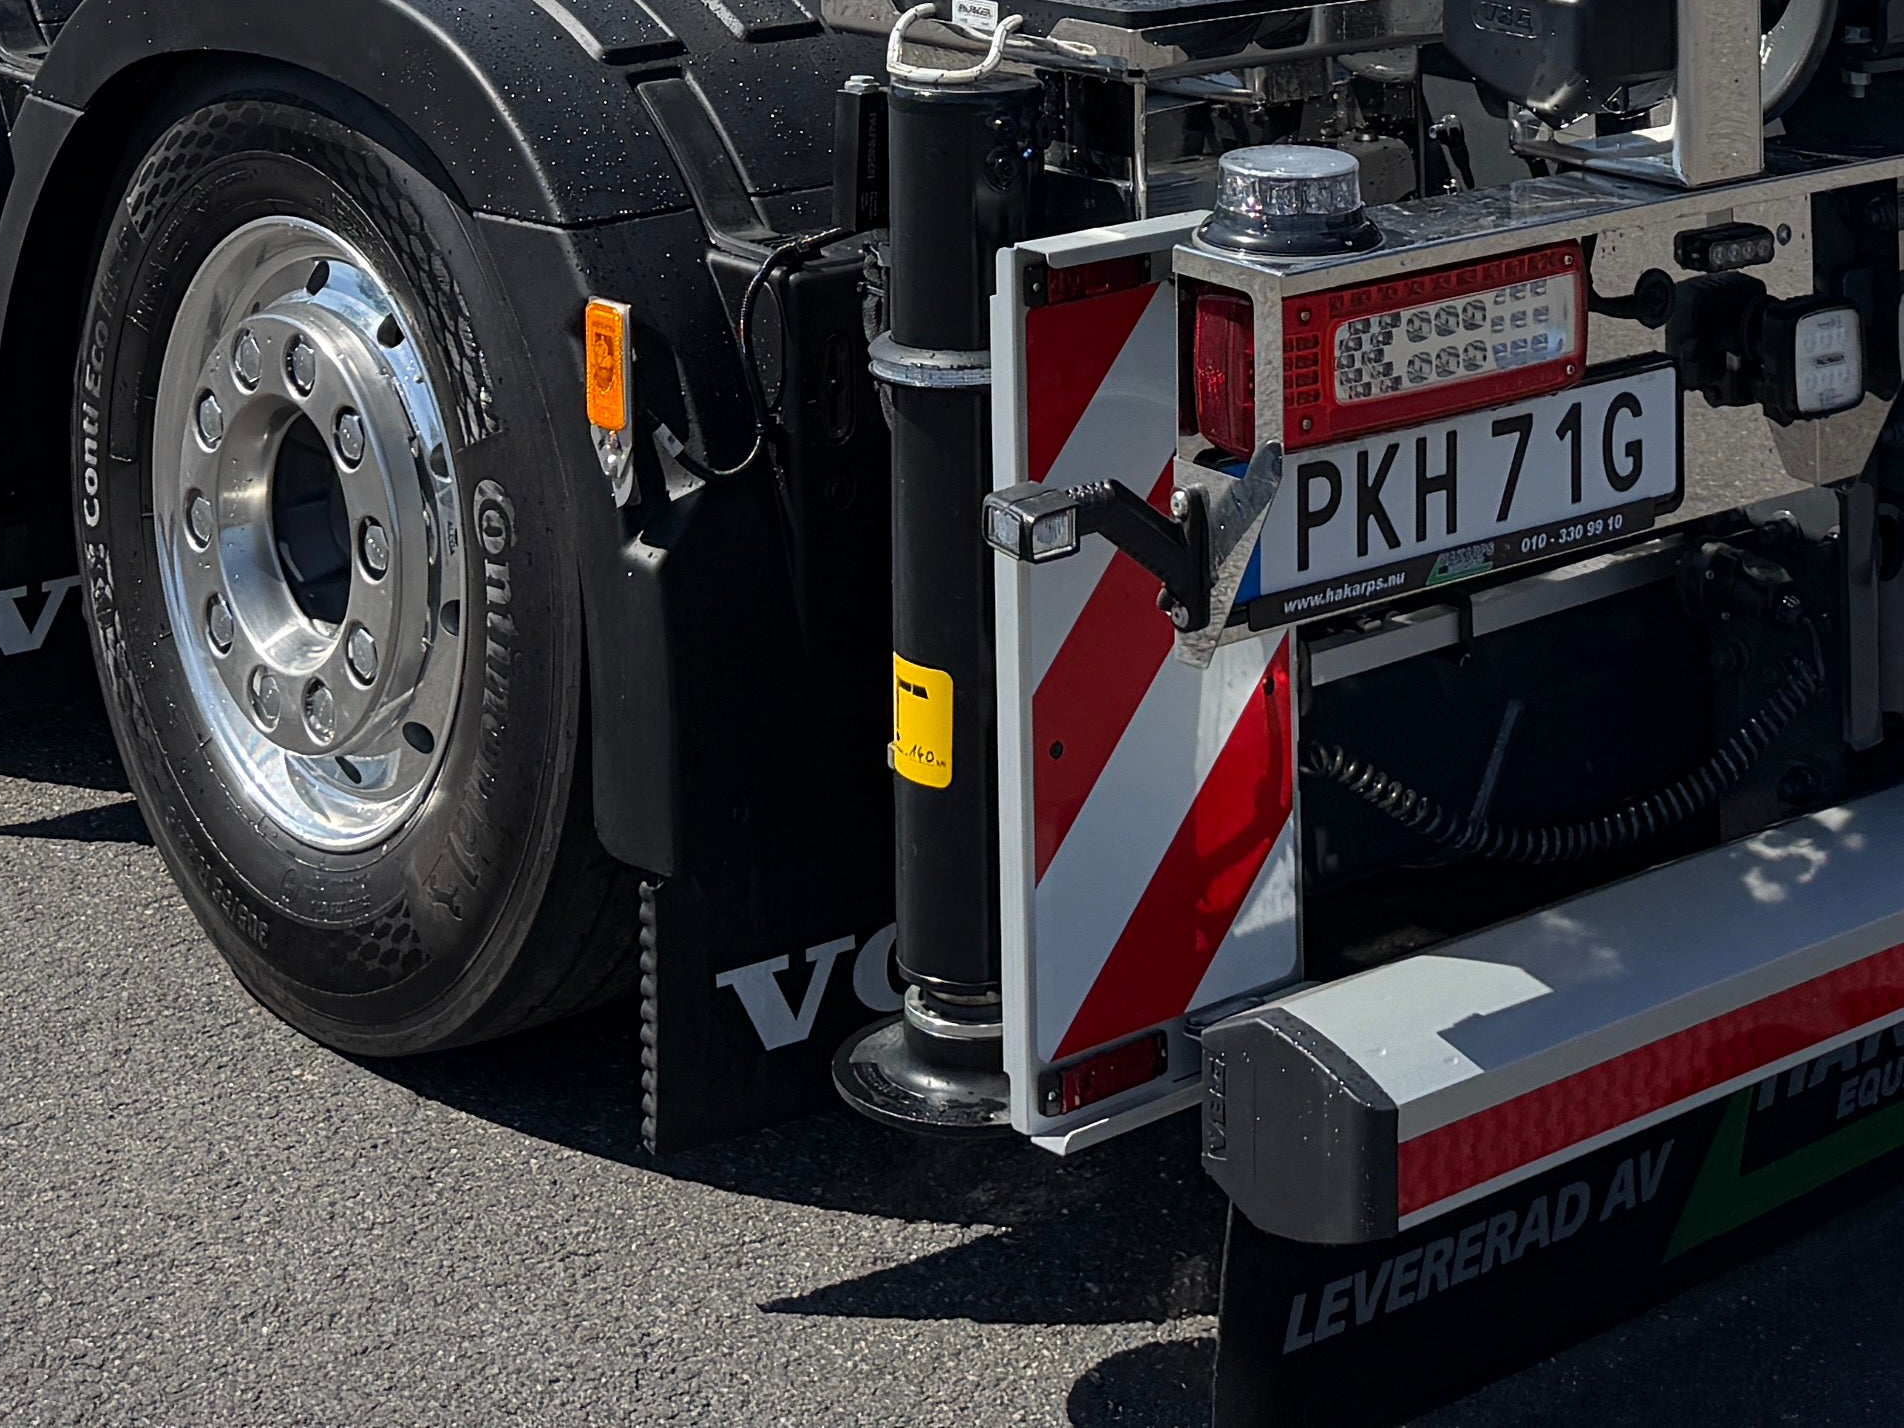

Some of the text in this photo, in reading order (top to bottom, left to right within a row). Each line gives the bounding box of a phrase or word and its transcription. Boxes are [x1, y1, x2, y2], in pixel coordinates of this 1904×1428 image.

[82, 401, 100, 527] Conti
[1297, 391, 1644, 572] PKH 71G
[1283, 572, 1406, 615] www.hakarps.nu
[1521, 534, 1546, 554] 010
[1559, 522, 1584, 545] 330
[1586, 518, 1604, 539] 99
[1607, 513, 1624, 532] 10
[1282, 1138, 1675, 1356] LEVERERAD AV
